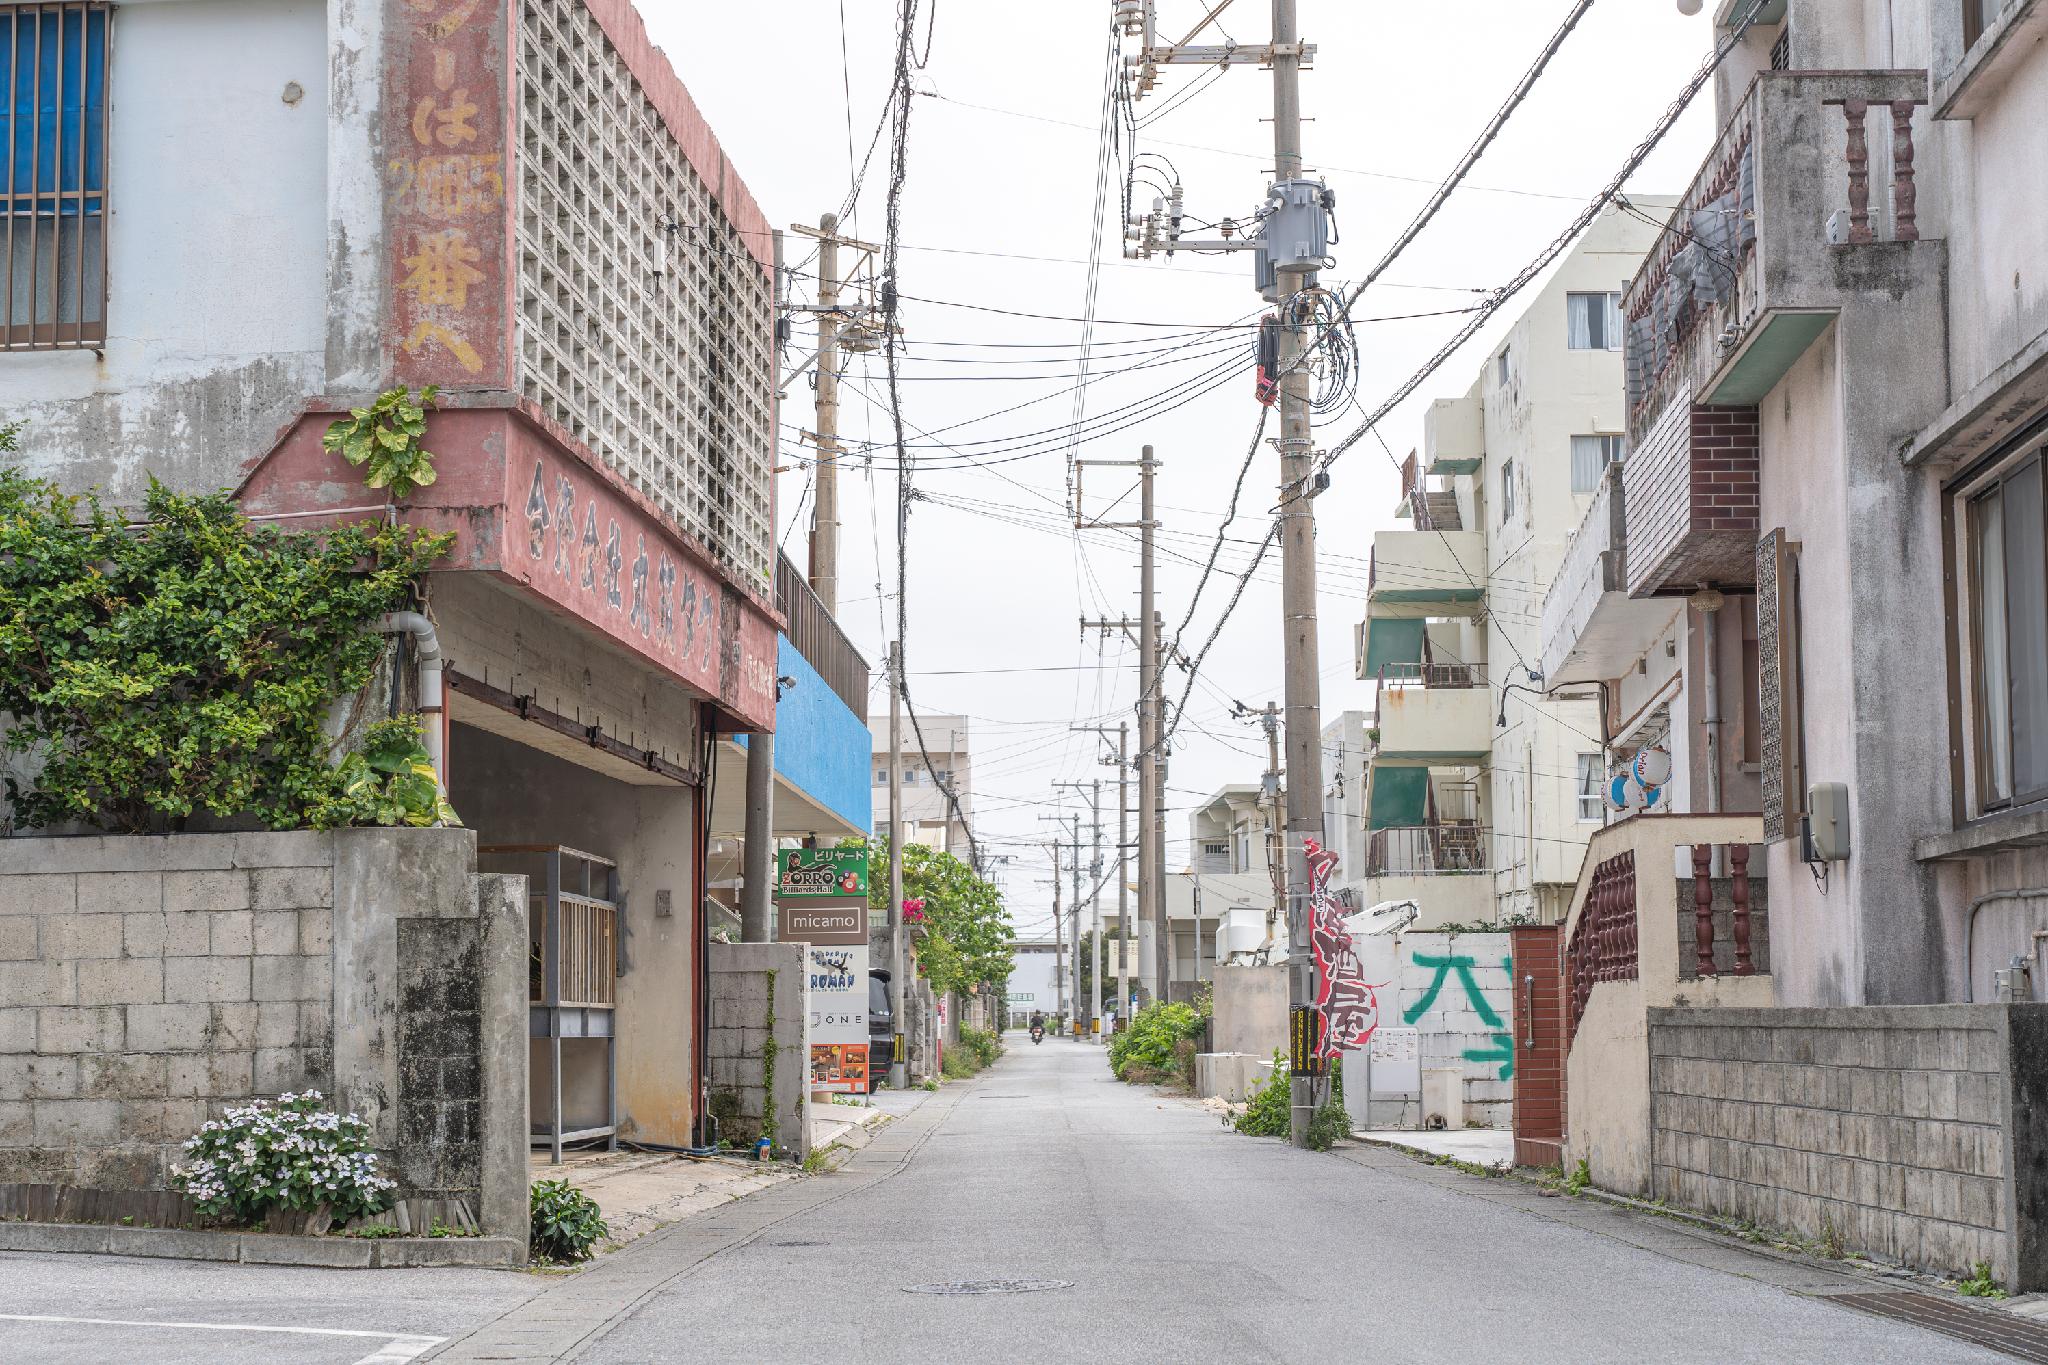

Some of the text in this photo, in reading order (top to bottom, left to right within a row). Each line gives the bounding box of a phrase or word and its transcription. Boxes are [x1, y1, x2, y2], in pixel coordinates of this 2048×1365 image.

[814, 851, 864, 861] ビリヤード
[783, 872, 835, 885] ZORRO
[794, 914, 854, 927] micamo
